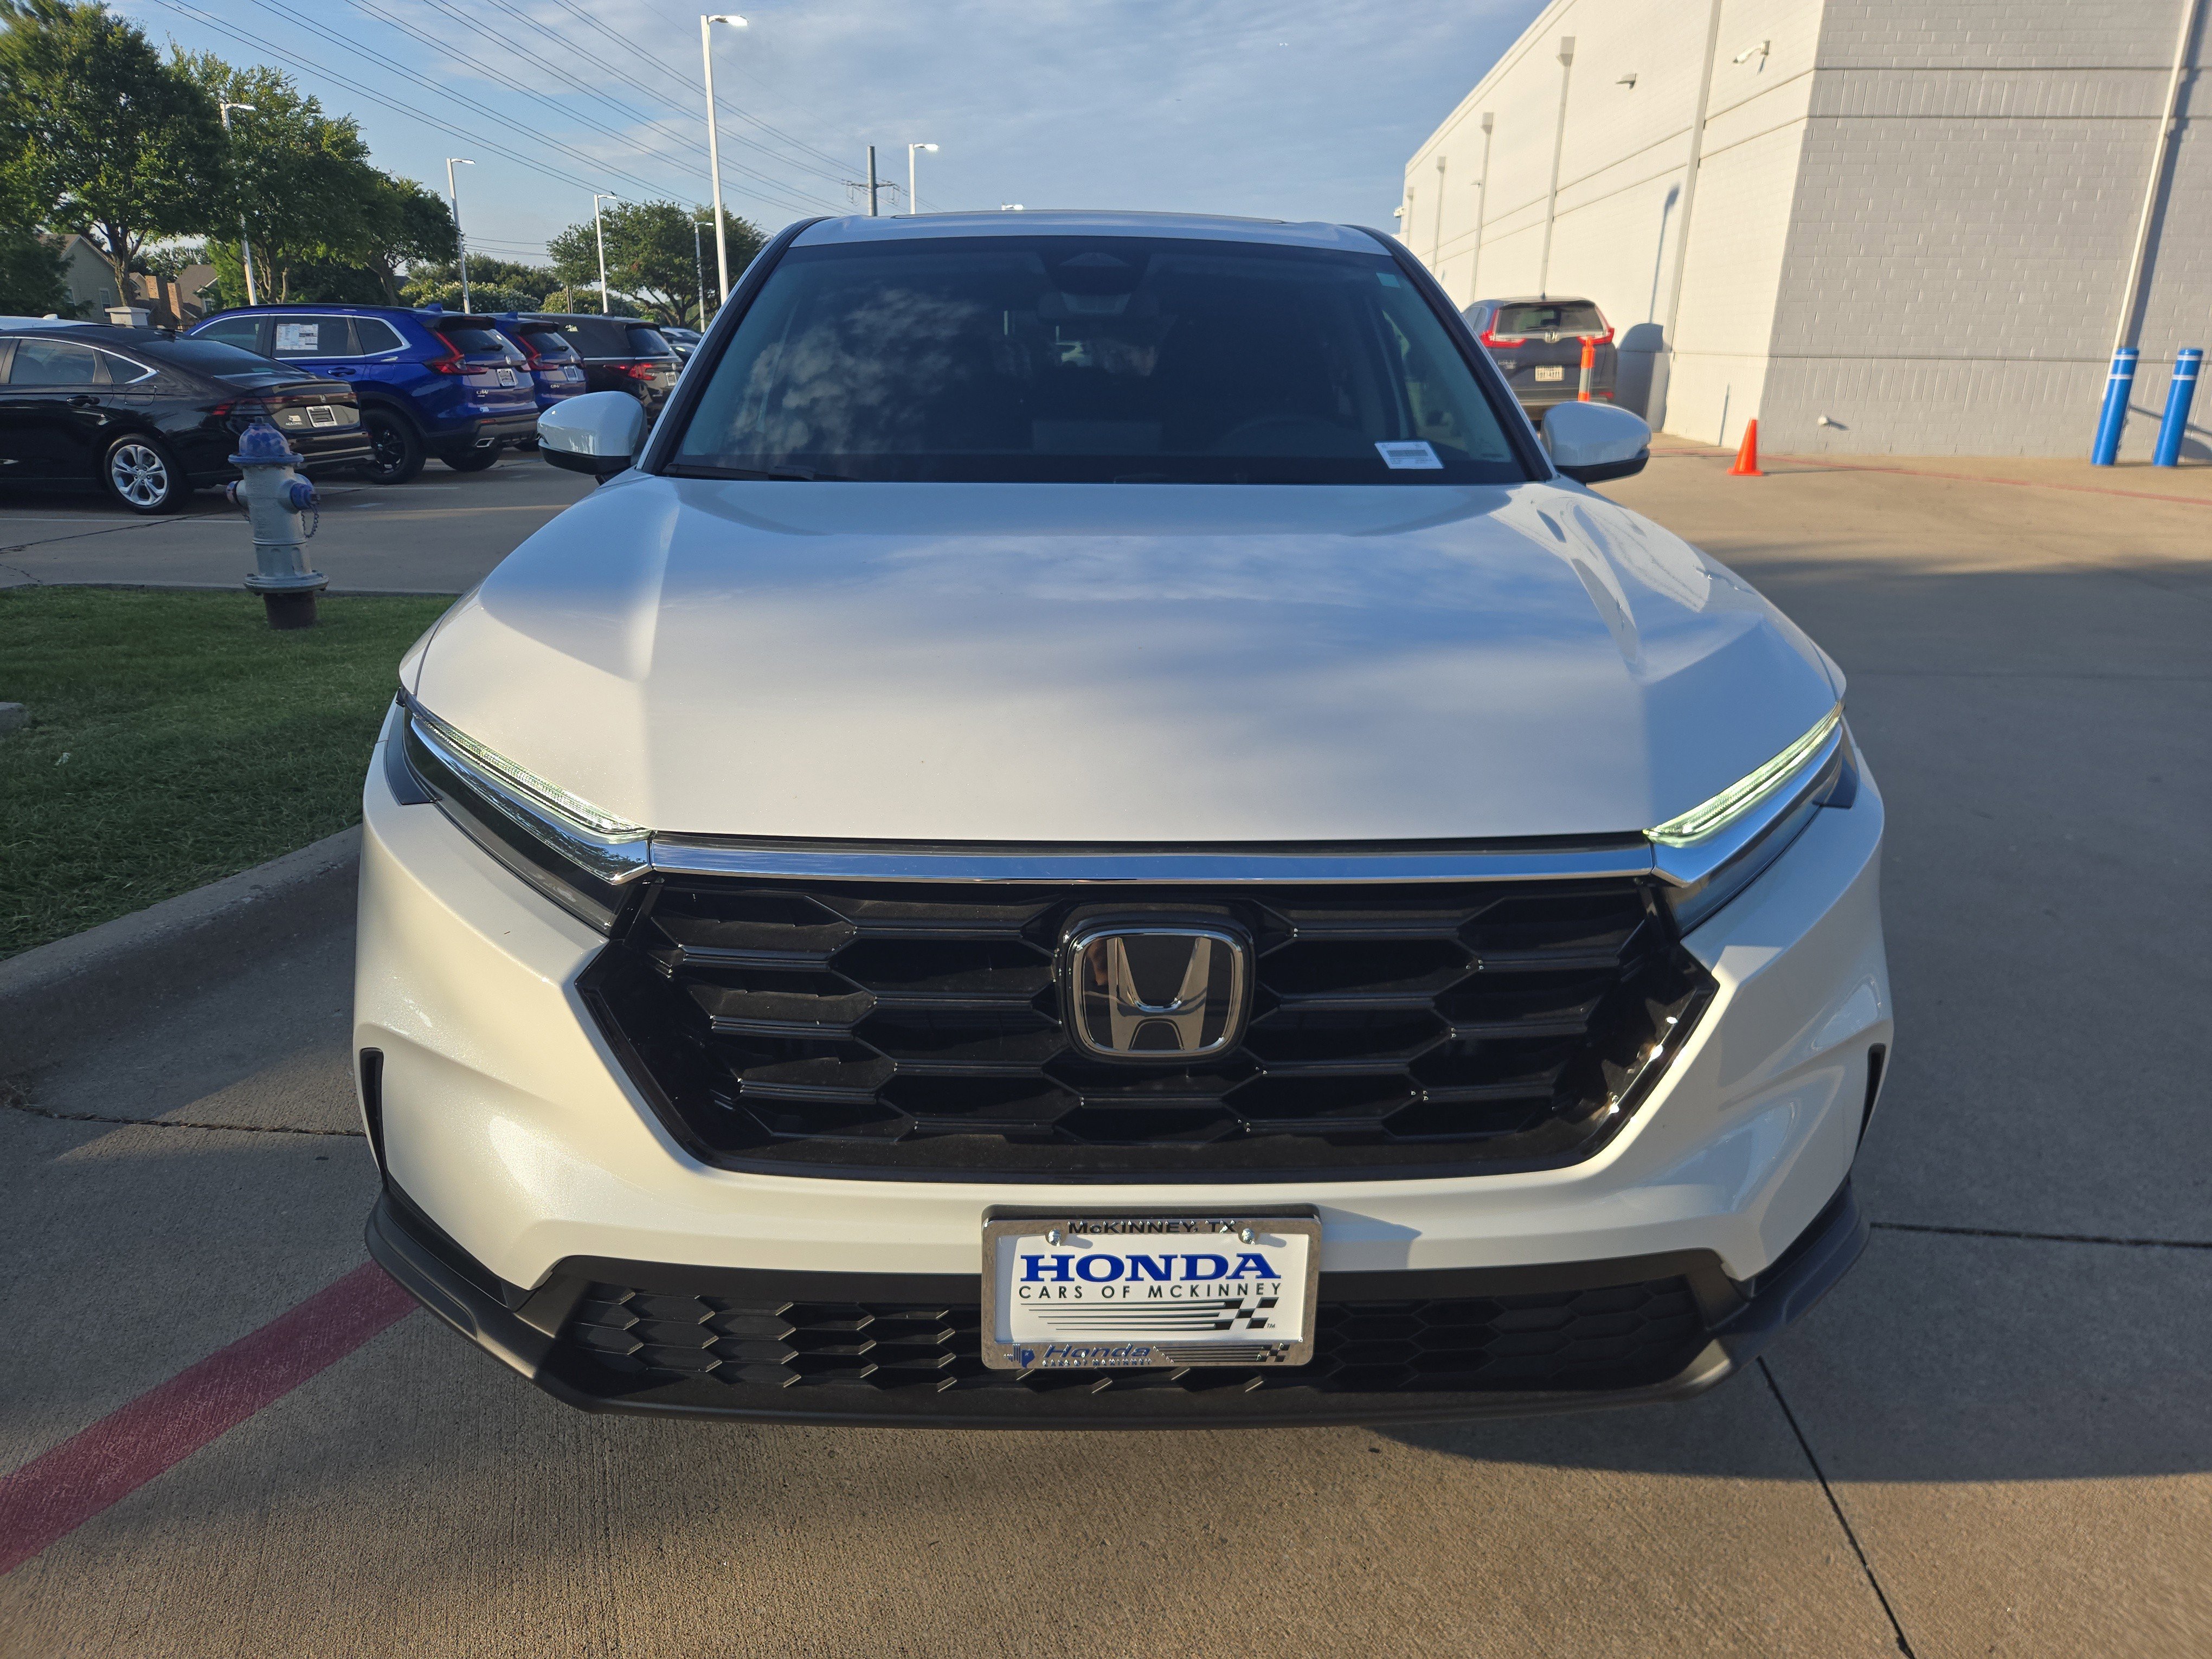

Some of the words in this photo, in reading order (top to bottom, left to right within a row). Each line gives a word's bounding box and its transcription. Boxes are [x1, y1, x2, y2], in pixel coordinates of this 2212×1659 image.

[1205, 1220, 1238, 1234] TX
[1020, 1252, 1282, 1283] HONDA
[1019, 1285, 1083, 1299] CARS
[1101, 1284, 1130, 1298] OF
[1147, 1282, 1281, 1298] MCKINNEY
[1042, 1342, 1152, 1358] Honda
